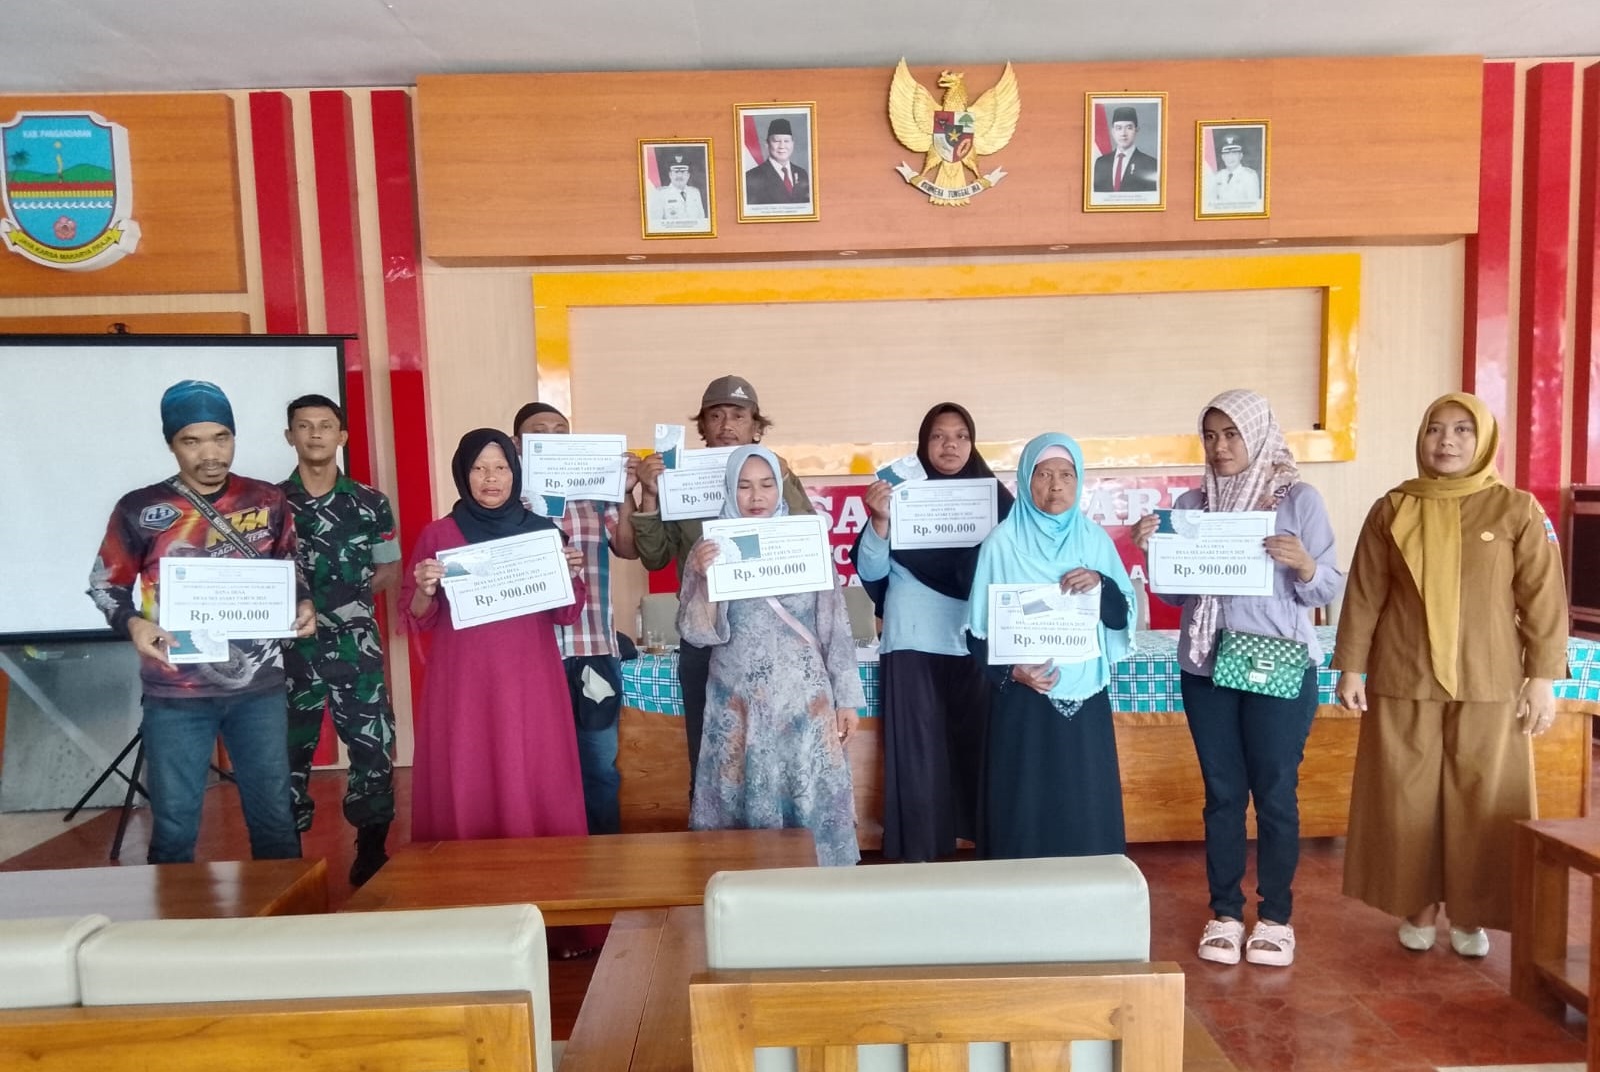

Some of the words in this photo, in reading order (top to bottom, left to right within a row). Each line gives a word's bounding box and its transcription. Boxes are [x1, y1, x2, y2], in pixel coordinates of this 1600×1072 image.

[545, 478, 564, 489] Rp.
[567, 477, 605, 488] 900.000
[681, 494, 701, 505] Rp.
[703, 491, 725, 501] 900.
[913, 525, 931, 536] Rp.
[934, 523, 976, 534] 900.000
[733, 569, 755, 581] Rp.
[758, 562, 806, 577] 900.000
[1173, 563, 1195, 577] Rp.
[1198, 563, 1247, 575] 900.000
[475, 594, 497, 607] Rp.
[500, 581, 547, 600] 900.000
[190, 610, 214, 623] Rp.
[218, 609, 270, 621] 900.000
[1013, 633, 1036, 647] Rp.
[1039, 634, 1087, 646] 900.000
